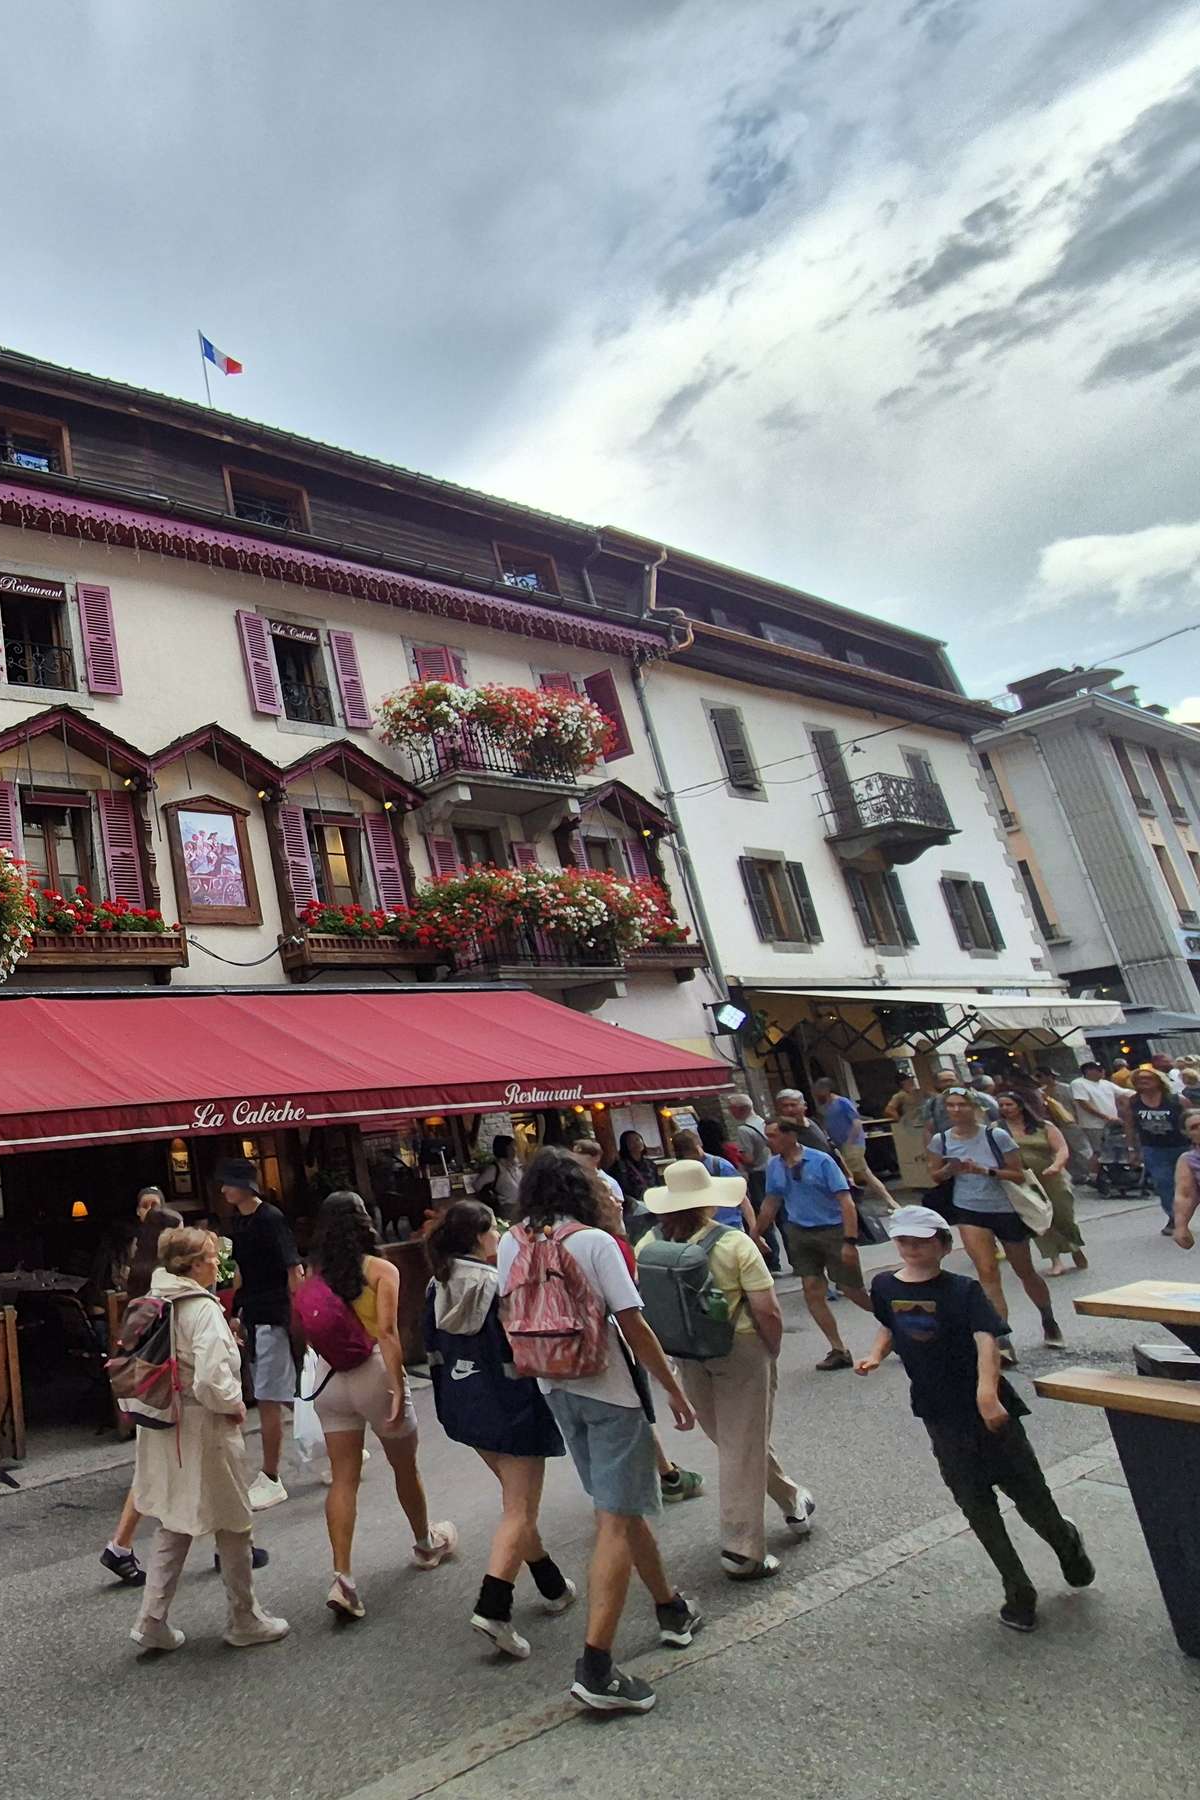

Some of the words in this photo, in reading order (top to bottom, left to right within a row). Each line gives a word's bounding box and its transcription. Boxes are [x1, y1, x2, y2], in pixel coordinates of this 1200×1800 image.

[0, 576, 63, 598] Restaurant
[503, 1083, 583, 1106] Restaurant
[191, 1103, 225, 1129] La
[232, 1100, 305, 1126] Calèche
